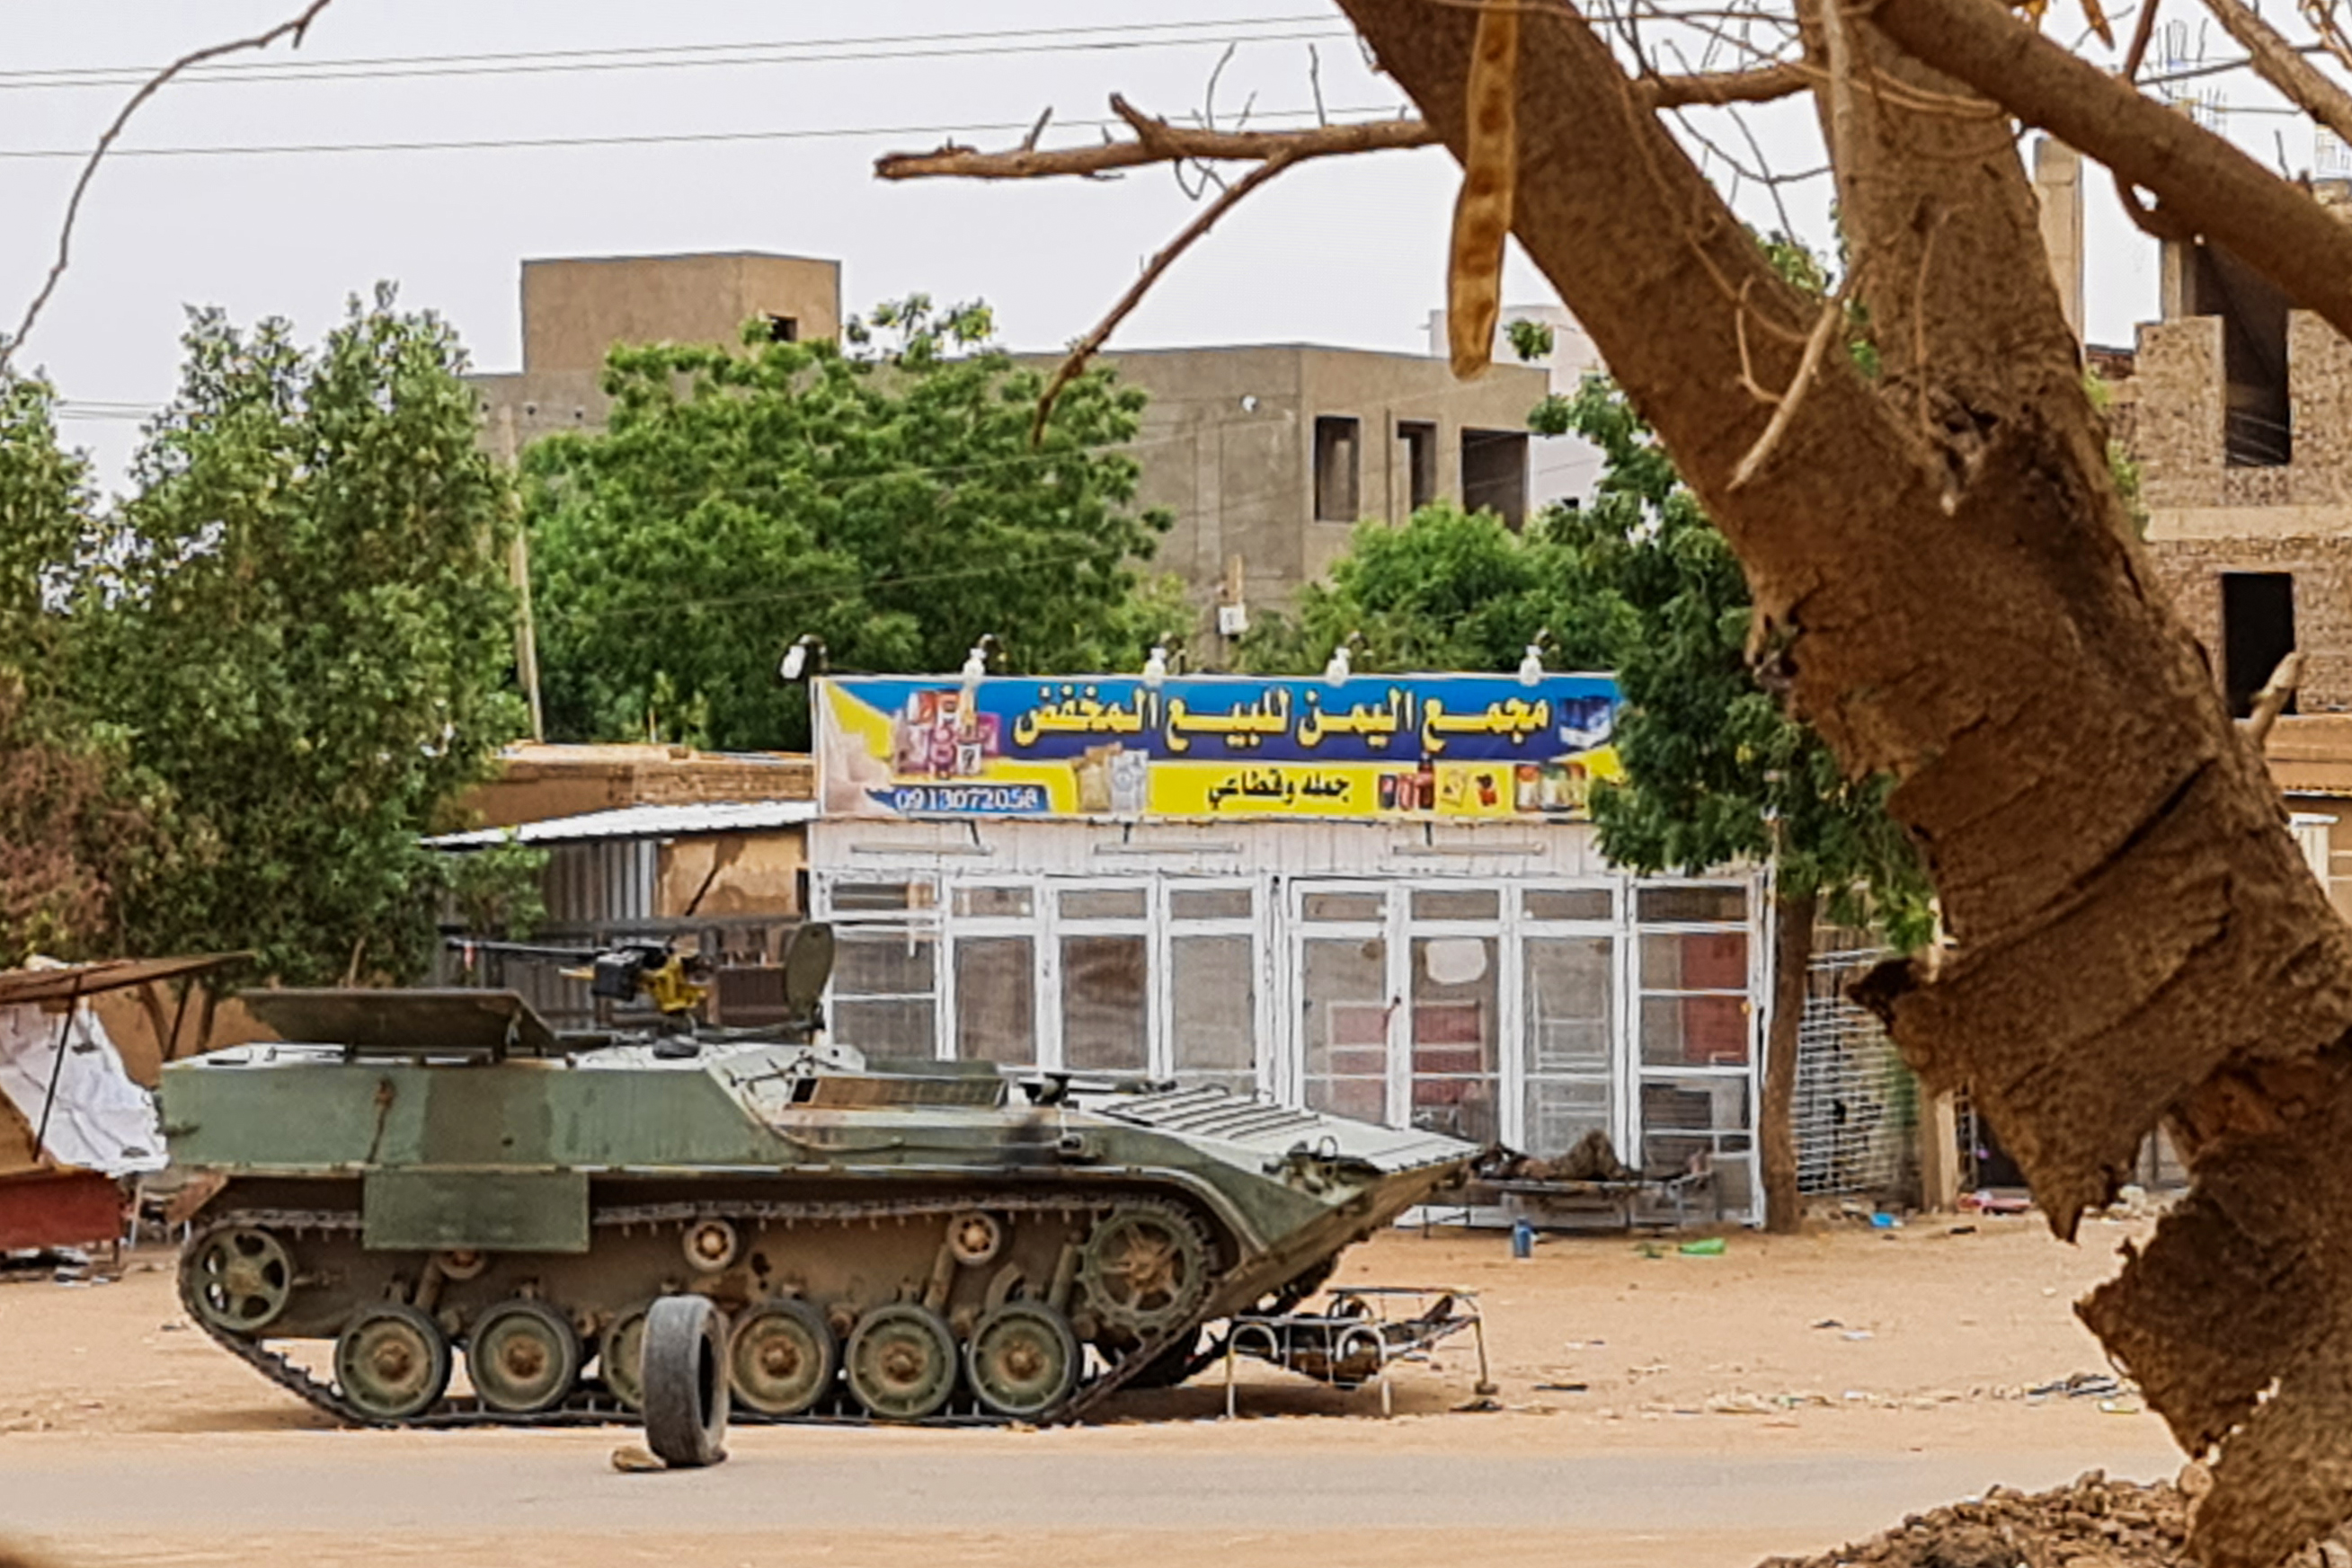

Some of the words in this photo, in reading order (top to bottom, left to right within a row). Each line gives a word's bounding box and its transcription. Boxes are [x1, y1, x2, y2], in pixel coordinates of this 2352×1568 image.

[1014, 685, 1158, 748] المخفض
[1167, 687, 1289, 753] للبيع
[1297, 687, 1414, 748] اليمن
[1422, 697, 1549, 753] مجمع
